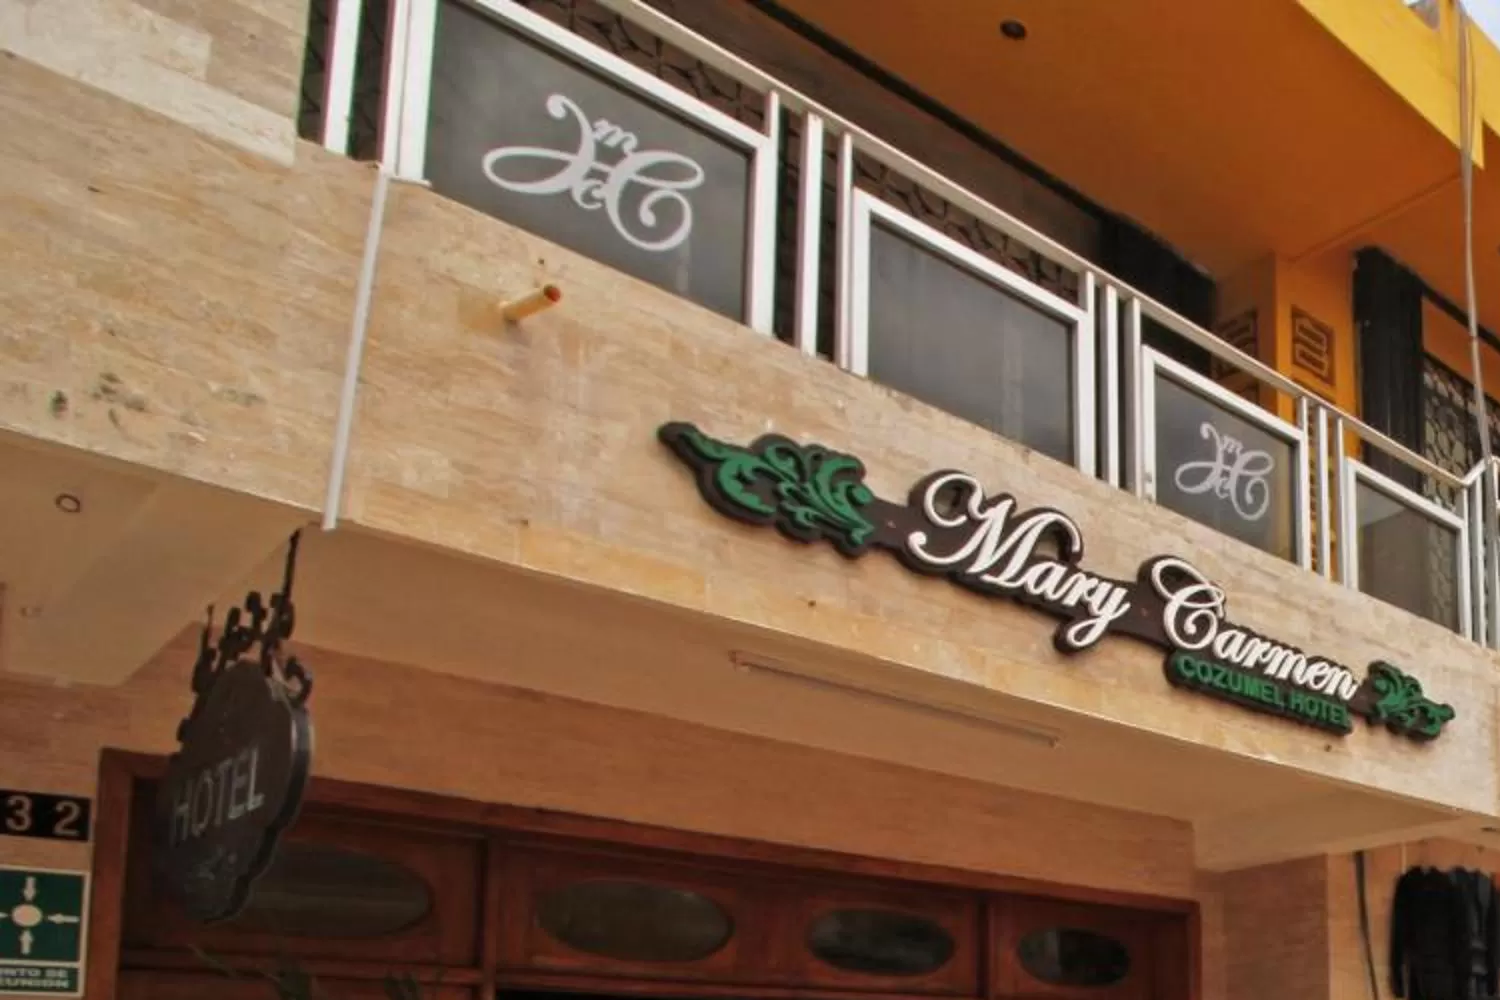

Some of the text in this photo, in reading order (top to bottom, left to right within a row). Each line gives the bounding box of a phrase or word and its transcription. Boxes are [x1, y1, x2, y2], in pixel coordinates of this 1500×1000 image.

[908, 472, 1131, 648] Mary
[1151, 557, 1360, 701] Carmen
[1177, 655, 1351, 727] COZUMEL HOTEL
[169, 745, 266, 849] HOTEL
